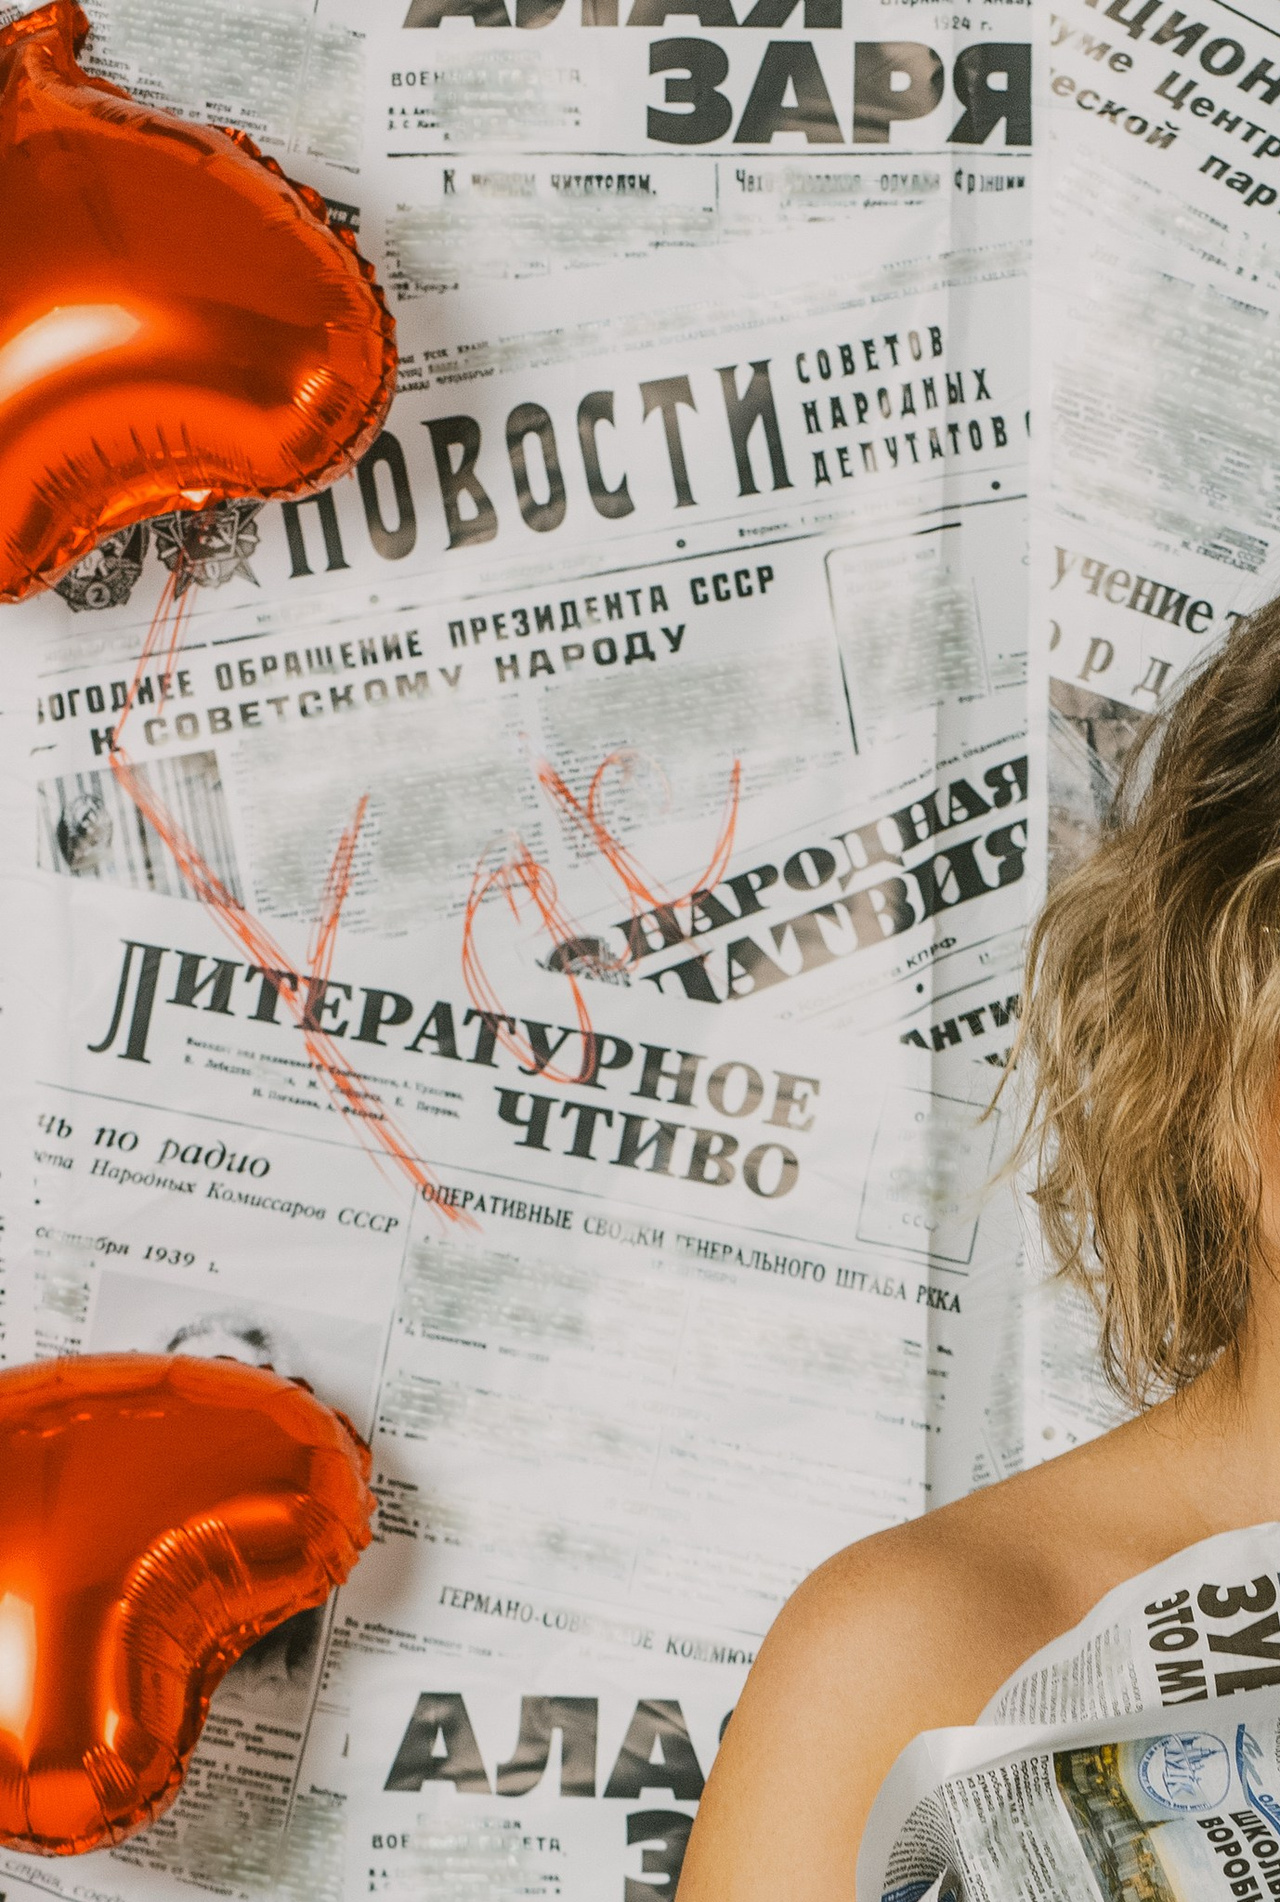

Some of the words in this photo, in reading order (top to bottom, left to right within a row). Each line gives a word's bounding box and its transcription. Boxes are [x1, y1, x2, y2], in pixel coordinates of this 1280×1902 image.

[646, 37, 1032, 145] ЗАРЯ
[795, 325, 946, 385] СОВЕТОВ
[802, 367, 993, 436] НАРОДНЫХ
[279, 357, 796, 580] НОВОСТИ
[812, 410, 1010, 487] ДЕПУТАТОВ
[215, 629, 424, 693] ОБРАЩЕНИЕ
[448, 584, 670, 647] ПРЕЗИДЕНТА
[690, 564, 776, 605] СССР
[1051, 541, 1215, 635] учение
[89, 727, 122, 757] К
[144, 664, 464, 747] СОВЕТСКОМУ
[494, 623, 689, 684] НАРОДУ
[611, 755, 1029, 965] НАРОДНАЯ
[87, 939, 821, 1133] ЛИТЕРАТУРНОЕ
[89, 1157, 197, 1198] Народных
[207, 1182, 326, 1223] Комиссаров
[337, 1208, 399, 1235] СССР
[94, 1125, 140, 1153] по
[160, 1139, 272, 1180] радио
[496, 1086, 800, 1200] ЧТИВО
[143, 1247, 196, 1270] 1939
[421, 1180, 573, 1231] ОПЕРАТИВНЫЕ
[583, 1214, 664, 1251] СВОДКИ
[676, 1233, 827, 1282] ГЕНЕРАЛЬНОГО
[835, 1267, 907, 1301] ШТАБА
[1144, 1589, 1198, 1652] ЭТО
[383, 1690, 739, 1803] АЛА
